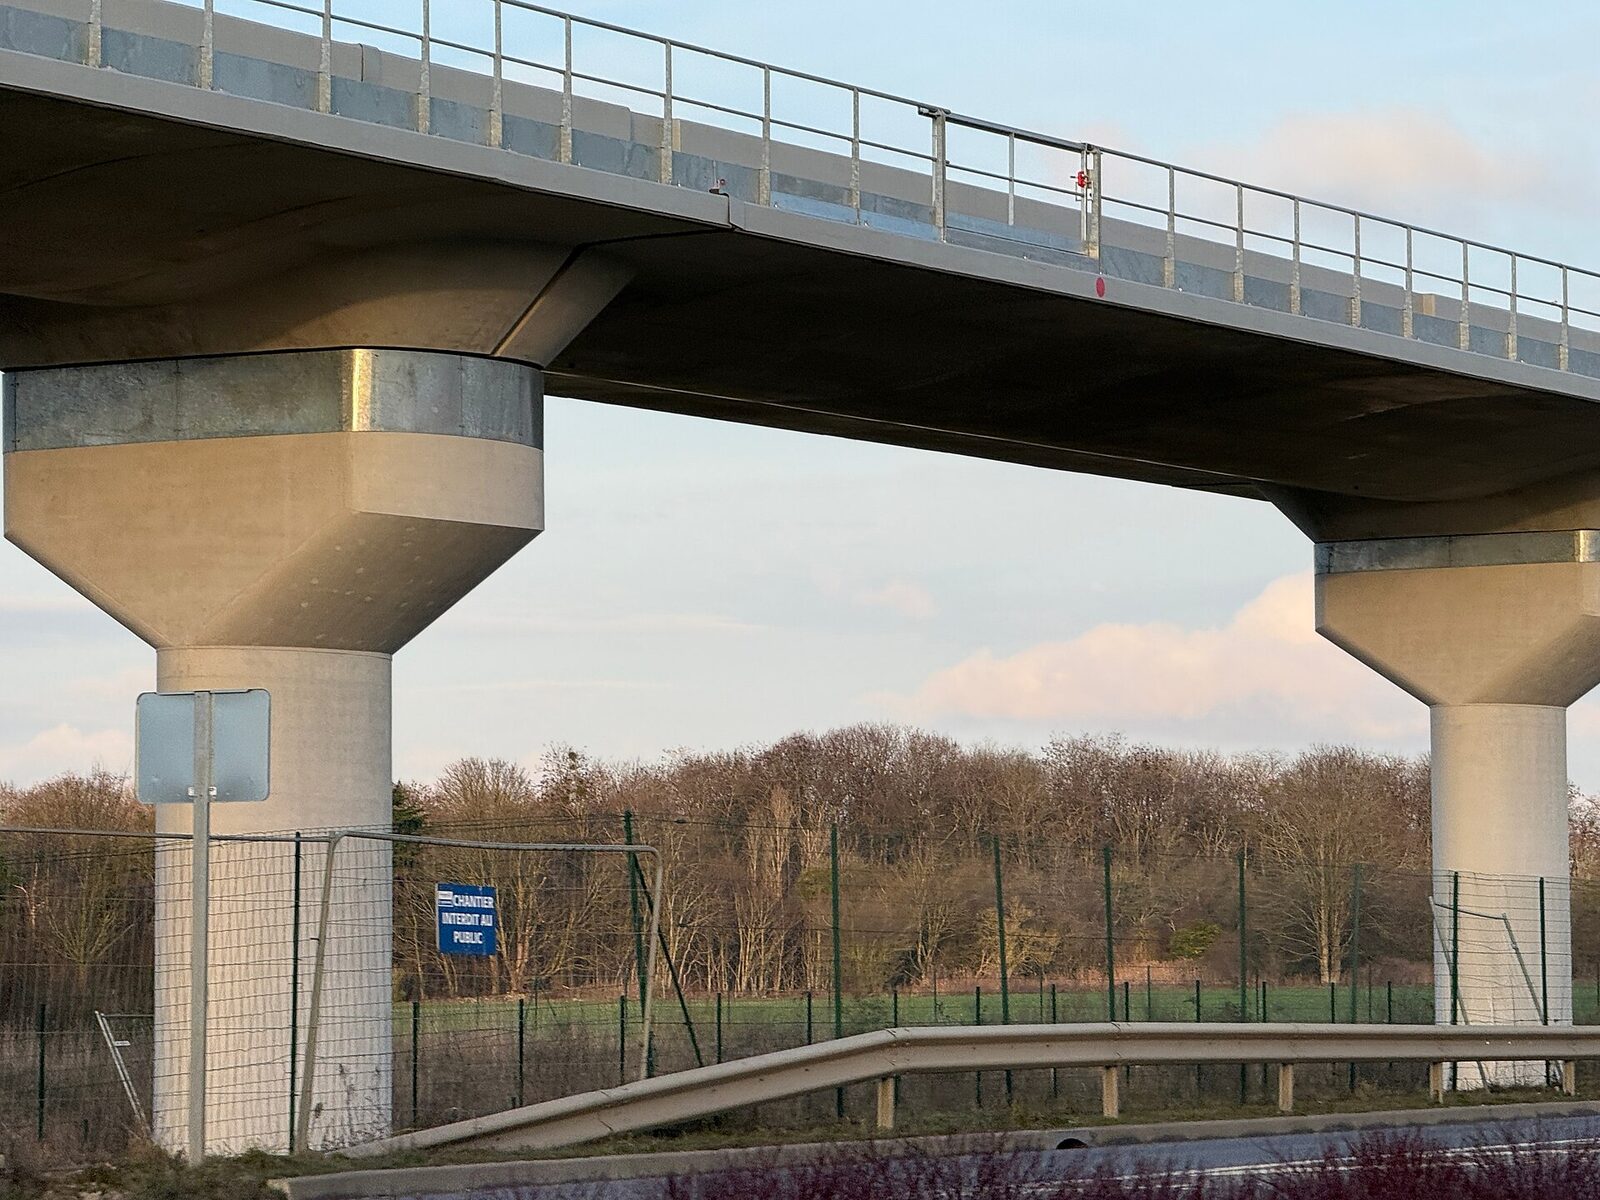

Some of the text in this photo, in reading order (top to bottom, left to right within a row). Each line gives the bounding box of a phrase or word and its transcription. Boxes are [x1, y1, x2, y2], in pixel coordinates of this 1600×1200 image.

[453, 894, 494, 909] CHANTIER
[441, 912, 493, 927] INTERDIT AU
[453, 930, 483, 944] PUBLIC
